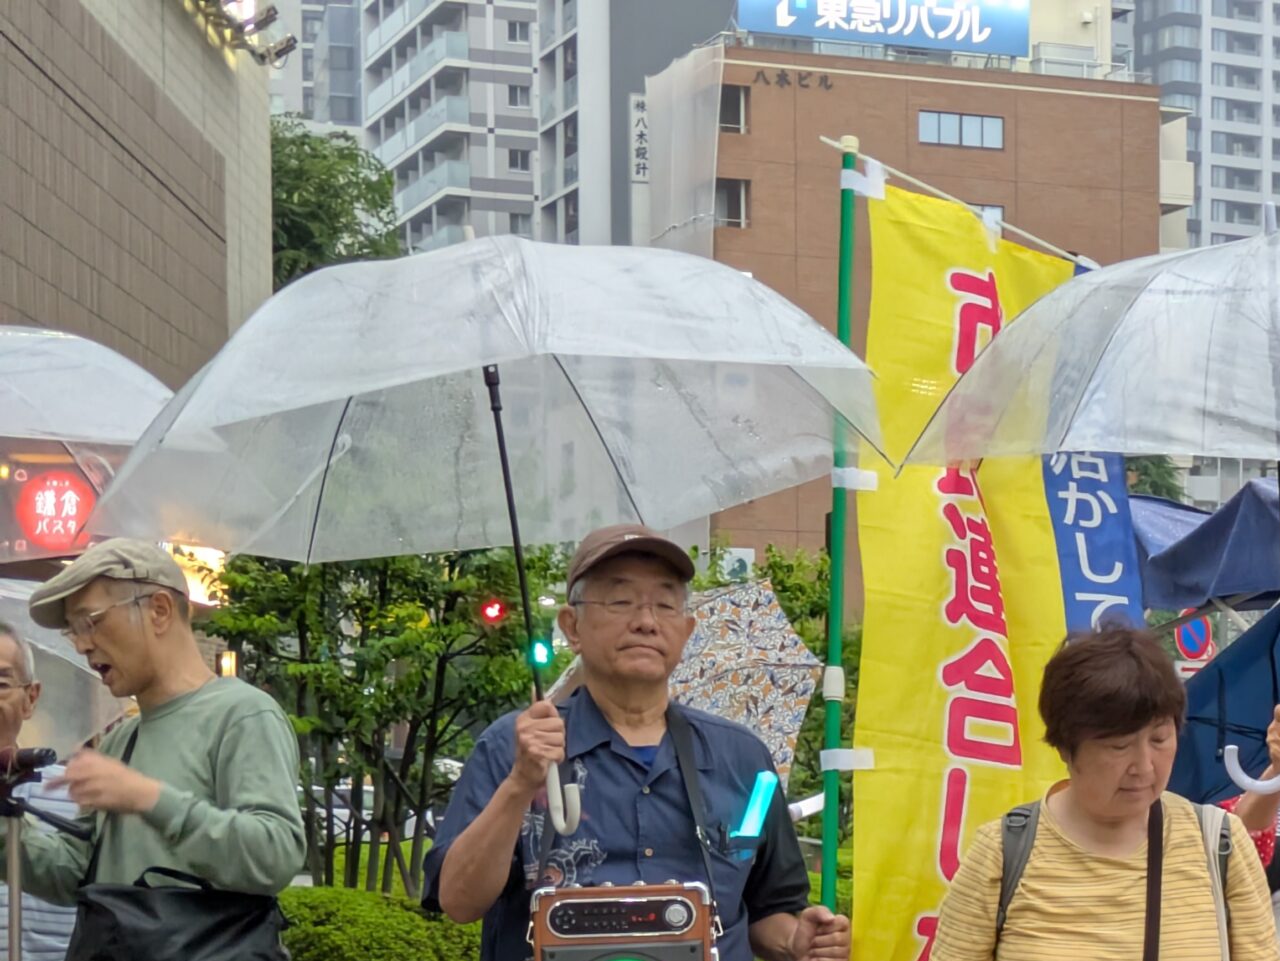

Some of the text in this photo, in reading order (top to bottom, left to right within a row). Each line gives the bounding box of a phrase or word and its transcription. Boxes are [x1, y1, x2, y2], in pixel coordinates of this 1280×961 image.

[814, 0, 992, 43] 東急リバブル
[753, 70, 833, 90] 八木ビル
[35, 489, 80, 517] 鎌倉
[36, 518, 76, 534] パスタ
